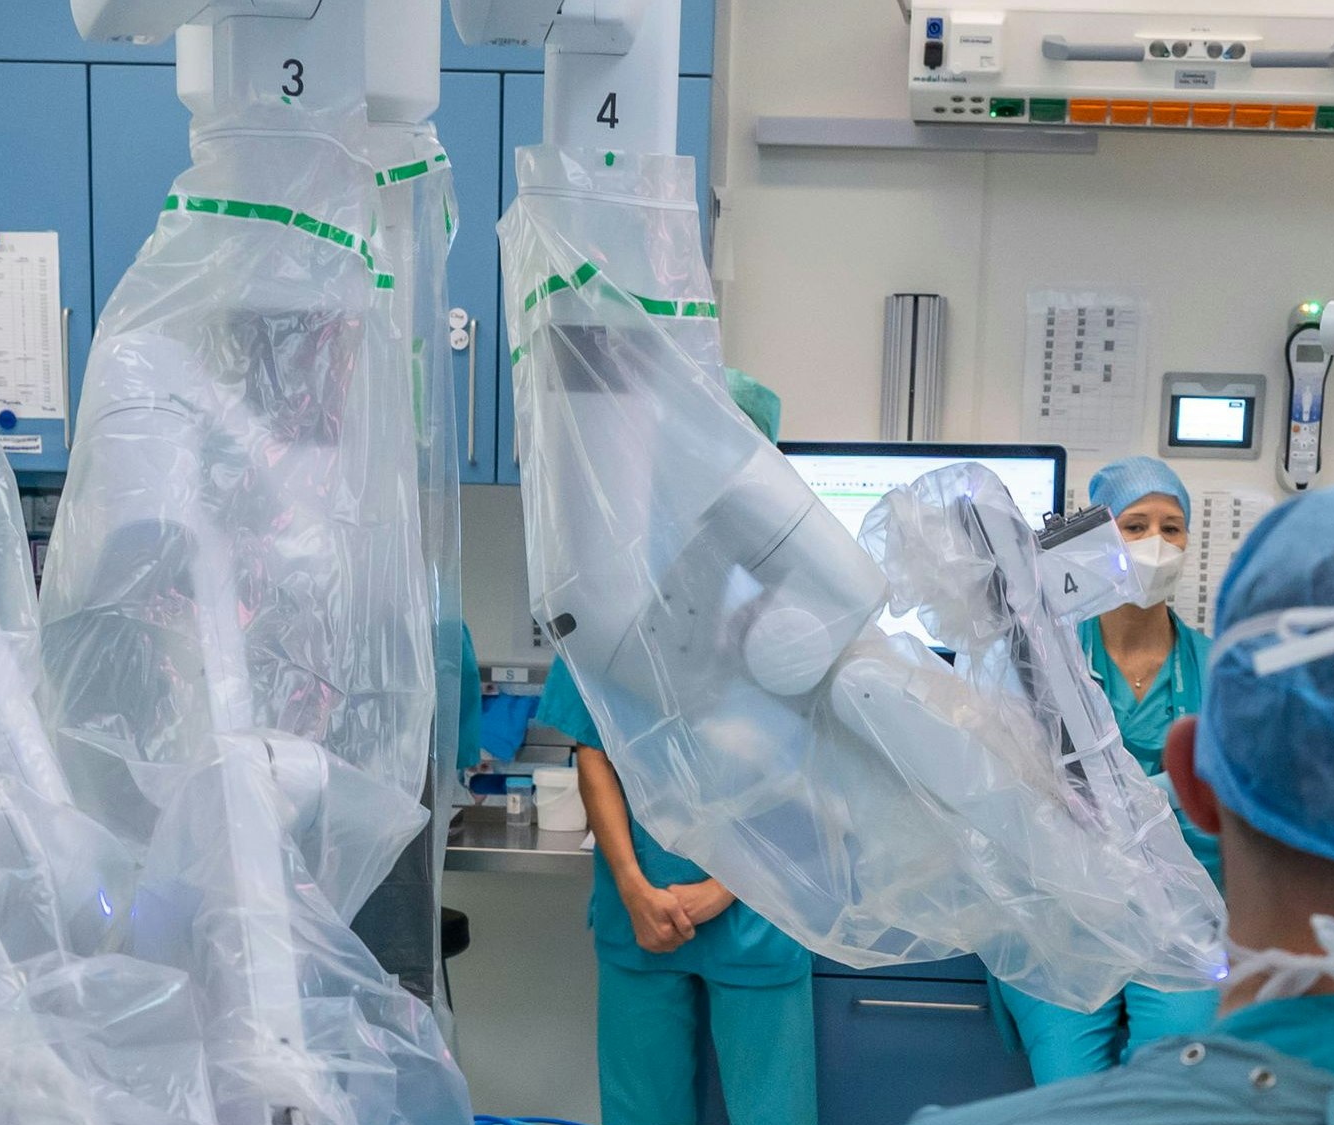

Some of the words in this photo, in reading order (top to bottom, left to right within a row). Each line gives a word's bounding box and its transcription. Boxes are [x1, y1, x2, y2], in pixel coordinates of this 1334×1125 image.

[282, 58, 304, 97] 3
[596, 92, 619, 129] 4
[1064, 572, 1078, 594] 4
[506, 669, 515, 680] S
